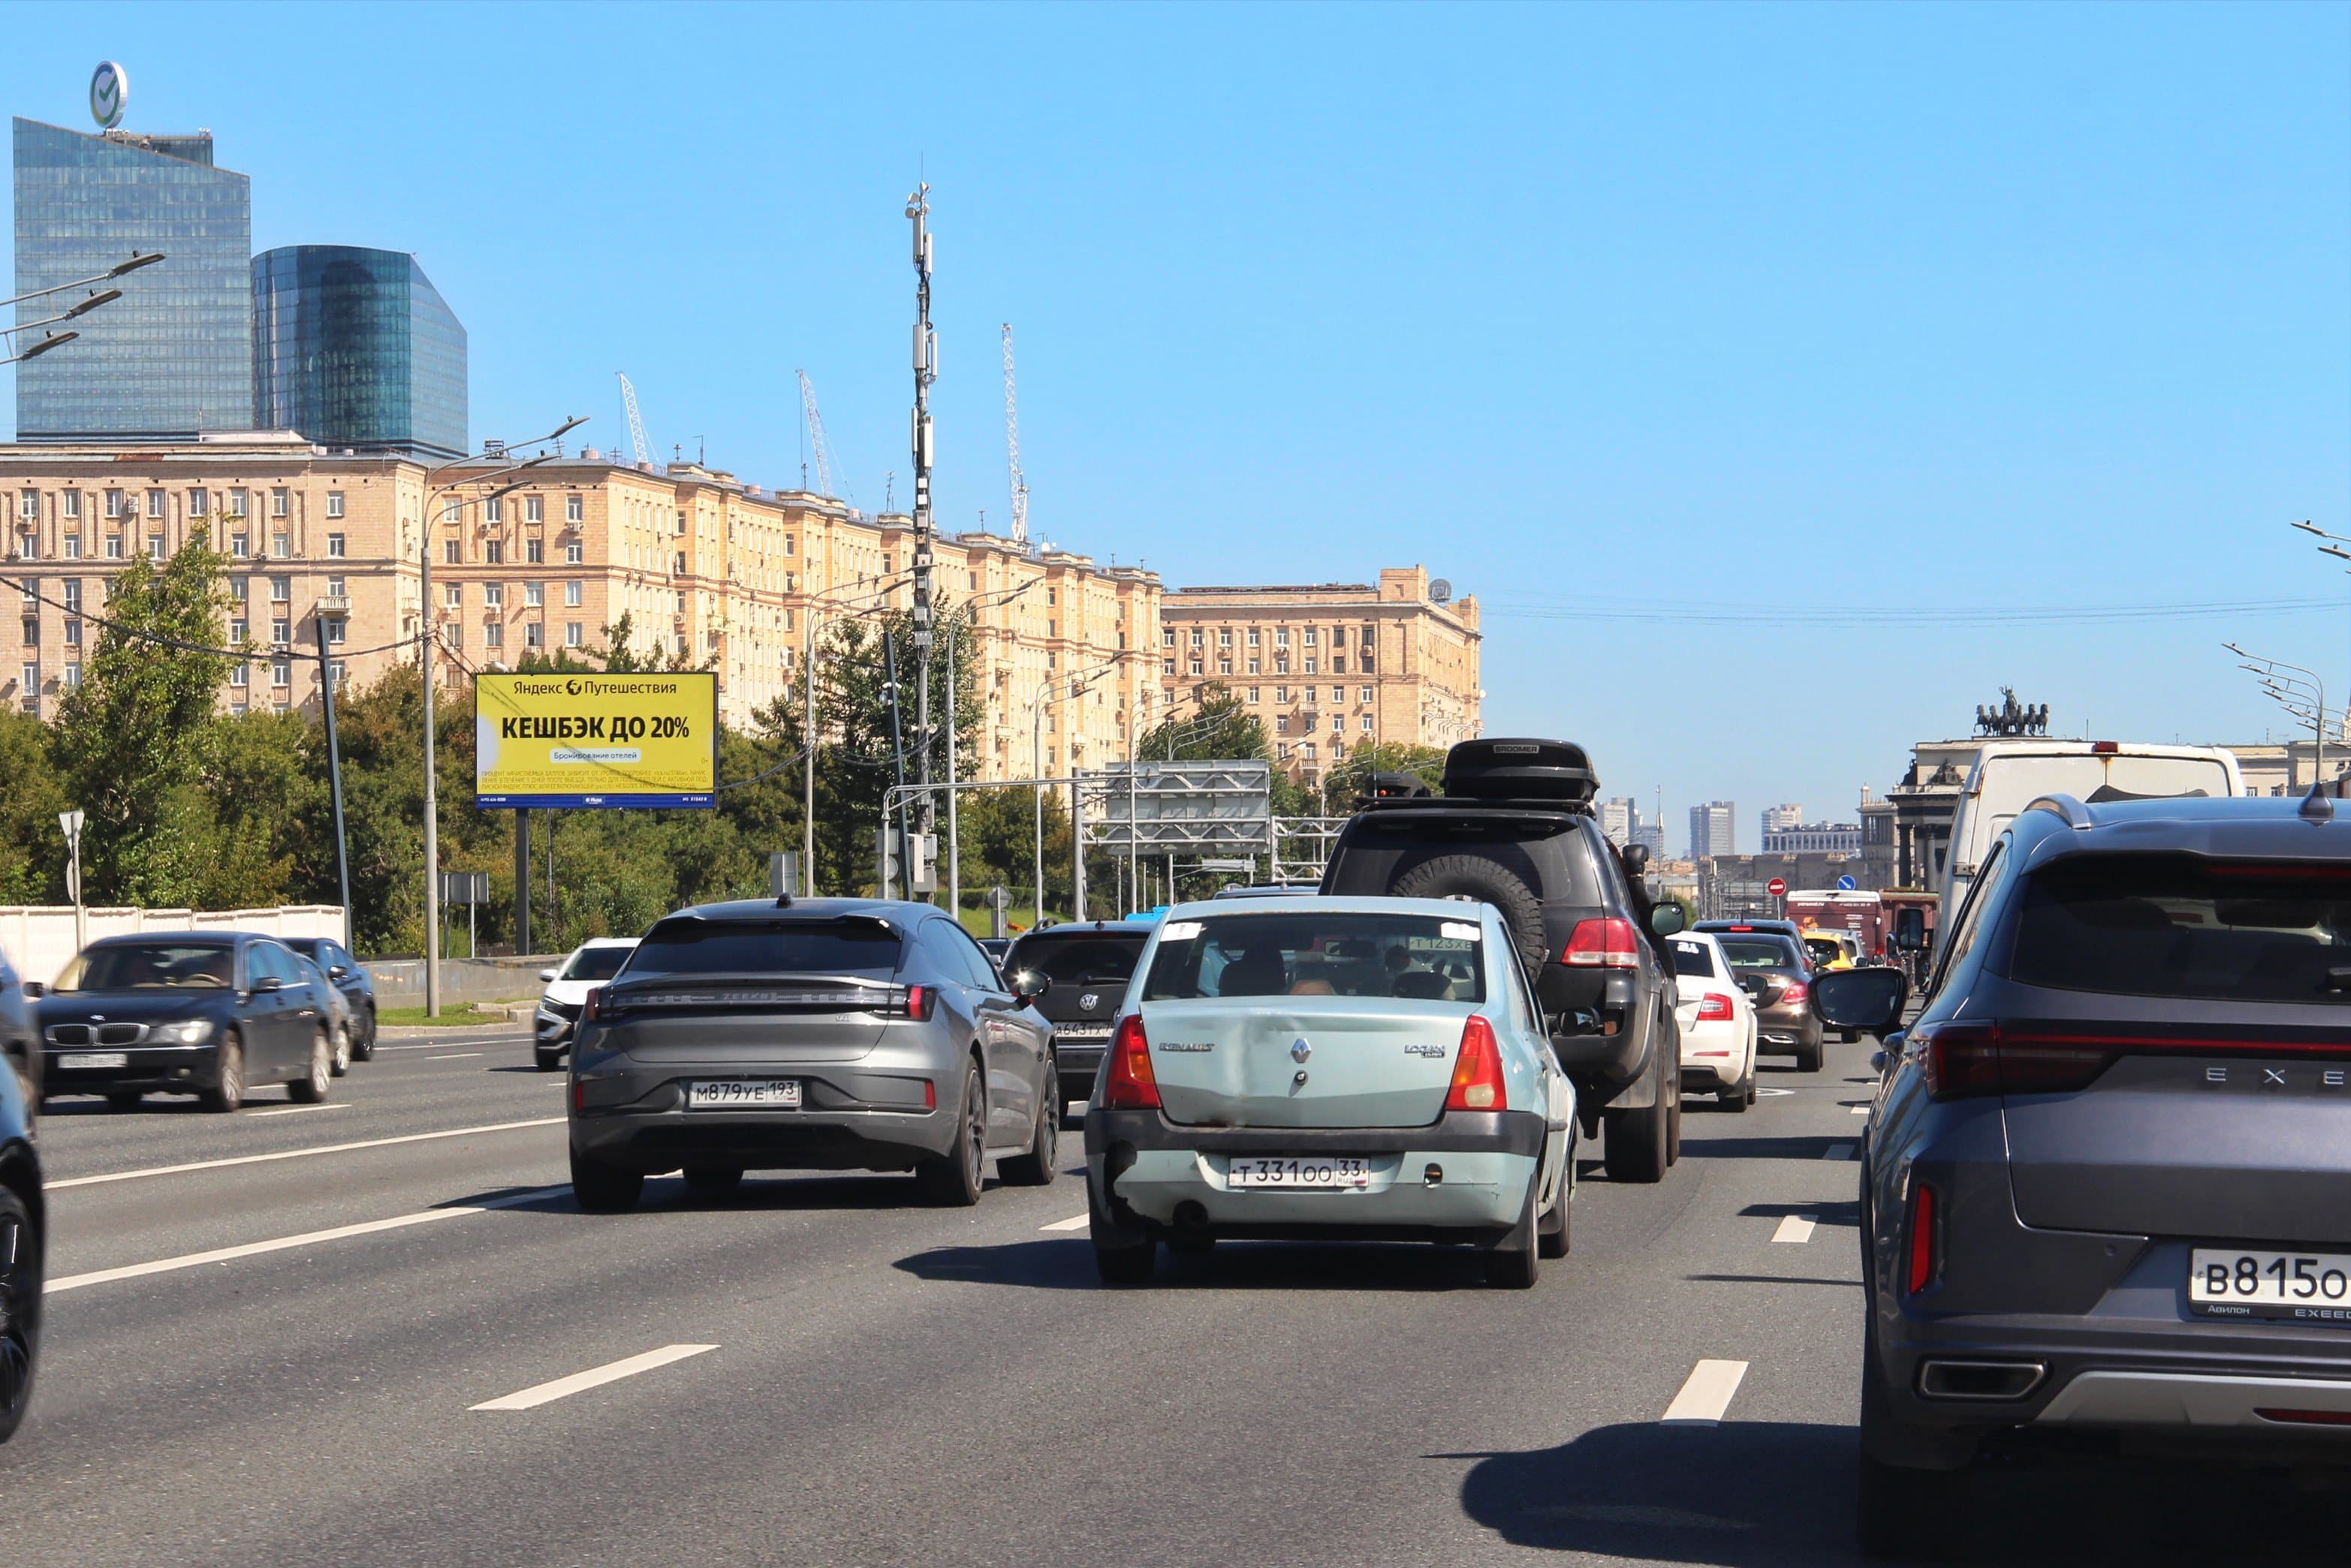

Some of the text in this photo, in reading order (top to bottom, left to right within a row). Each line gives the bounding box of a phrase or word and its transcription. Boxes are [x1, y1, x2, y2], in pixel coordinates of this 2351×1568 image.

[514, 681, 677, 696] Яндекс Путешествия
[502, 716, 689, 743] КЕШБЭК ДО 20%
[553, 752, 609, 760] Бронирование
[1056, 1023, 1102, 1035] А643ТХ
[696, 1082, 794, 1100] М879УЕ 193
[1240, 1160, 1361, 1183] Т331ОО 33
[2206, 1256, 2347, 1300] В815О
[2208, 1304, 2250, 1315] Авилон
